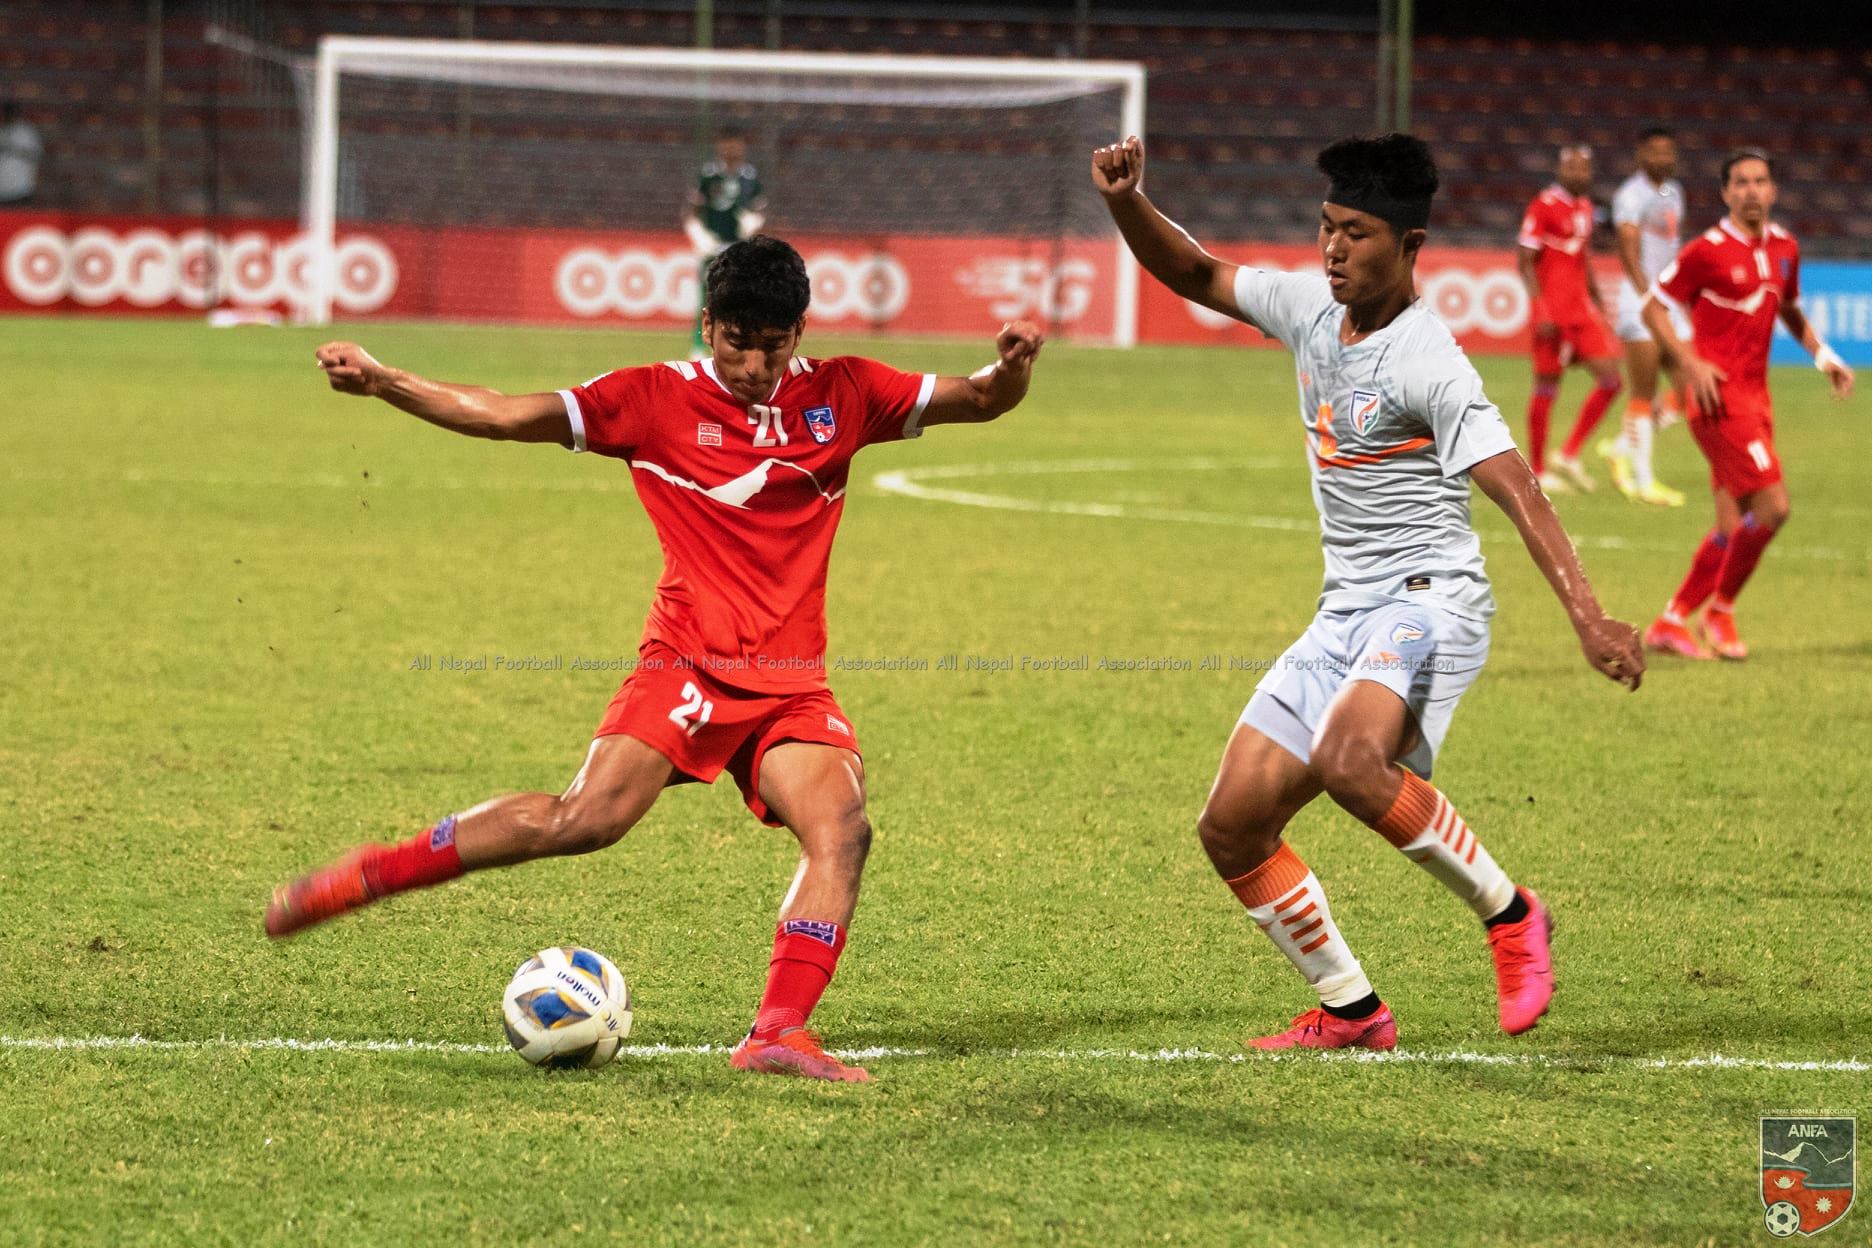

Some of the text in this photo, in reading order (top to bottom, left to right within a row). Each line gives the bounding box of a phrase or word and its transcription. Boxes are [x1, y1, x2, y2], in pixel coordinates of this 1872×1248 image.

[747, 403, 789, 447] 21
[668, 681, 714, 737] 21
[556, 971, 601, 1007] molten
